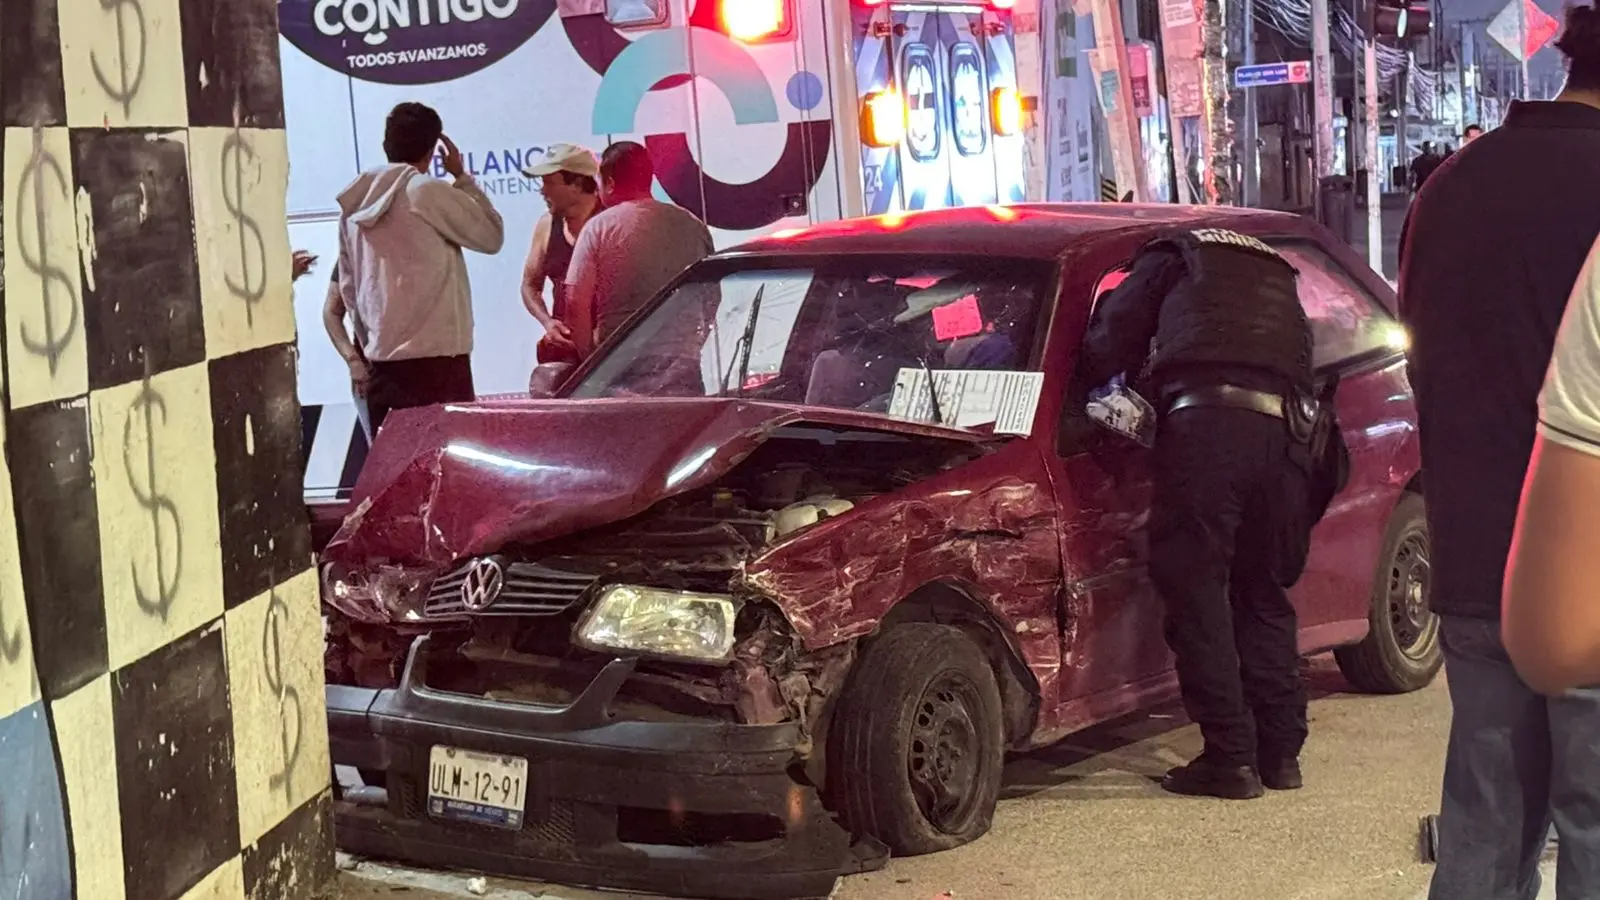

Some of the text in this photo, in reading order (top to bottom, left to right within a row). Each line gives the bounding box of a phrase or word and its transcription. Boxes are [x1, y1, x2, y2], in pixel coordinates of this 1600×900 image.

[347, 43, 489, 68] TODOS AVANZAMOS
[431, 761, 520, 807] ULM-12-91
